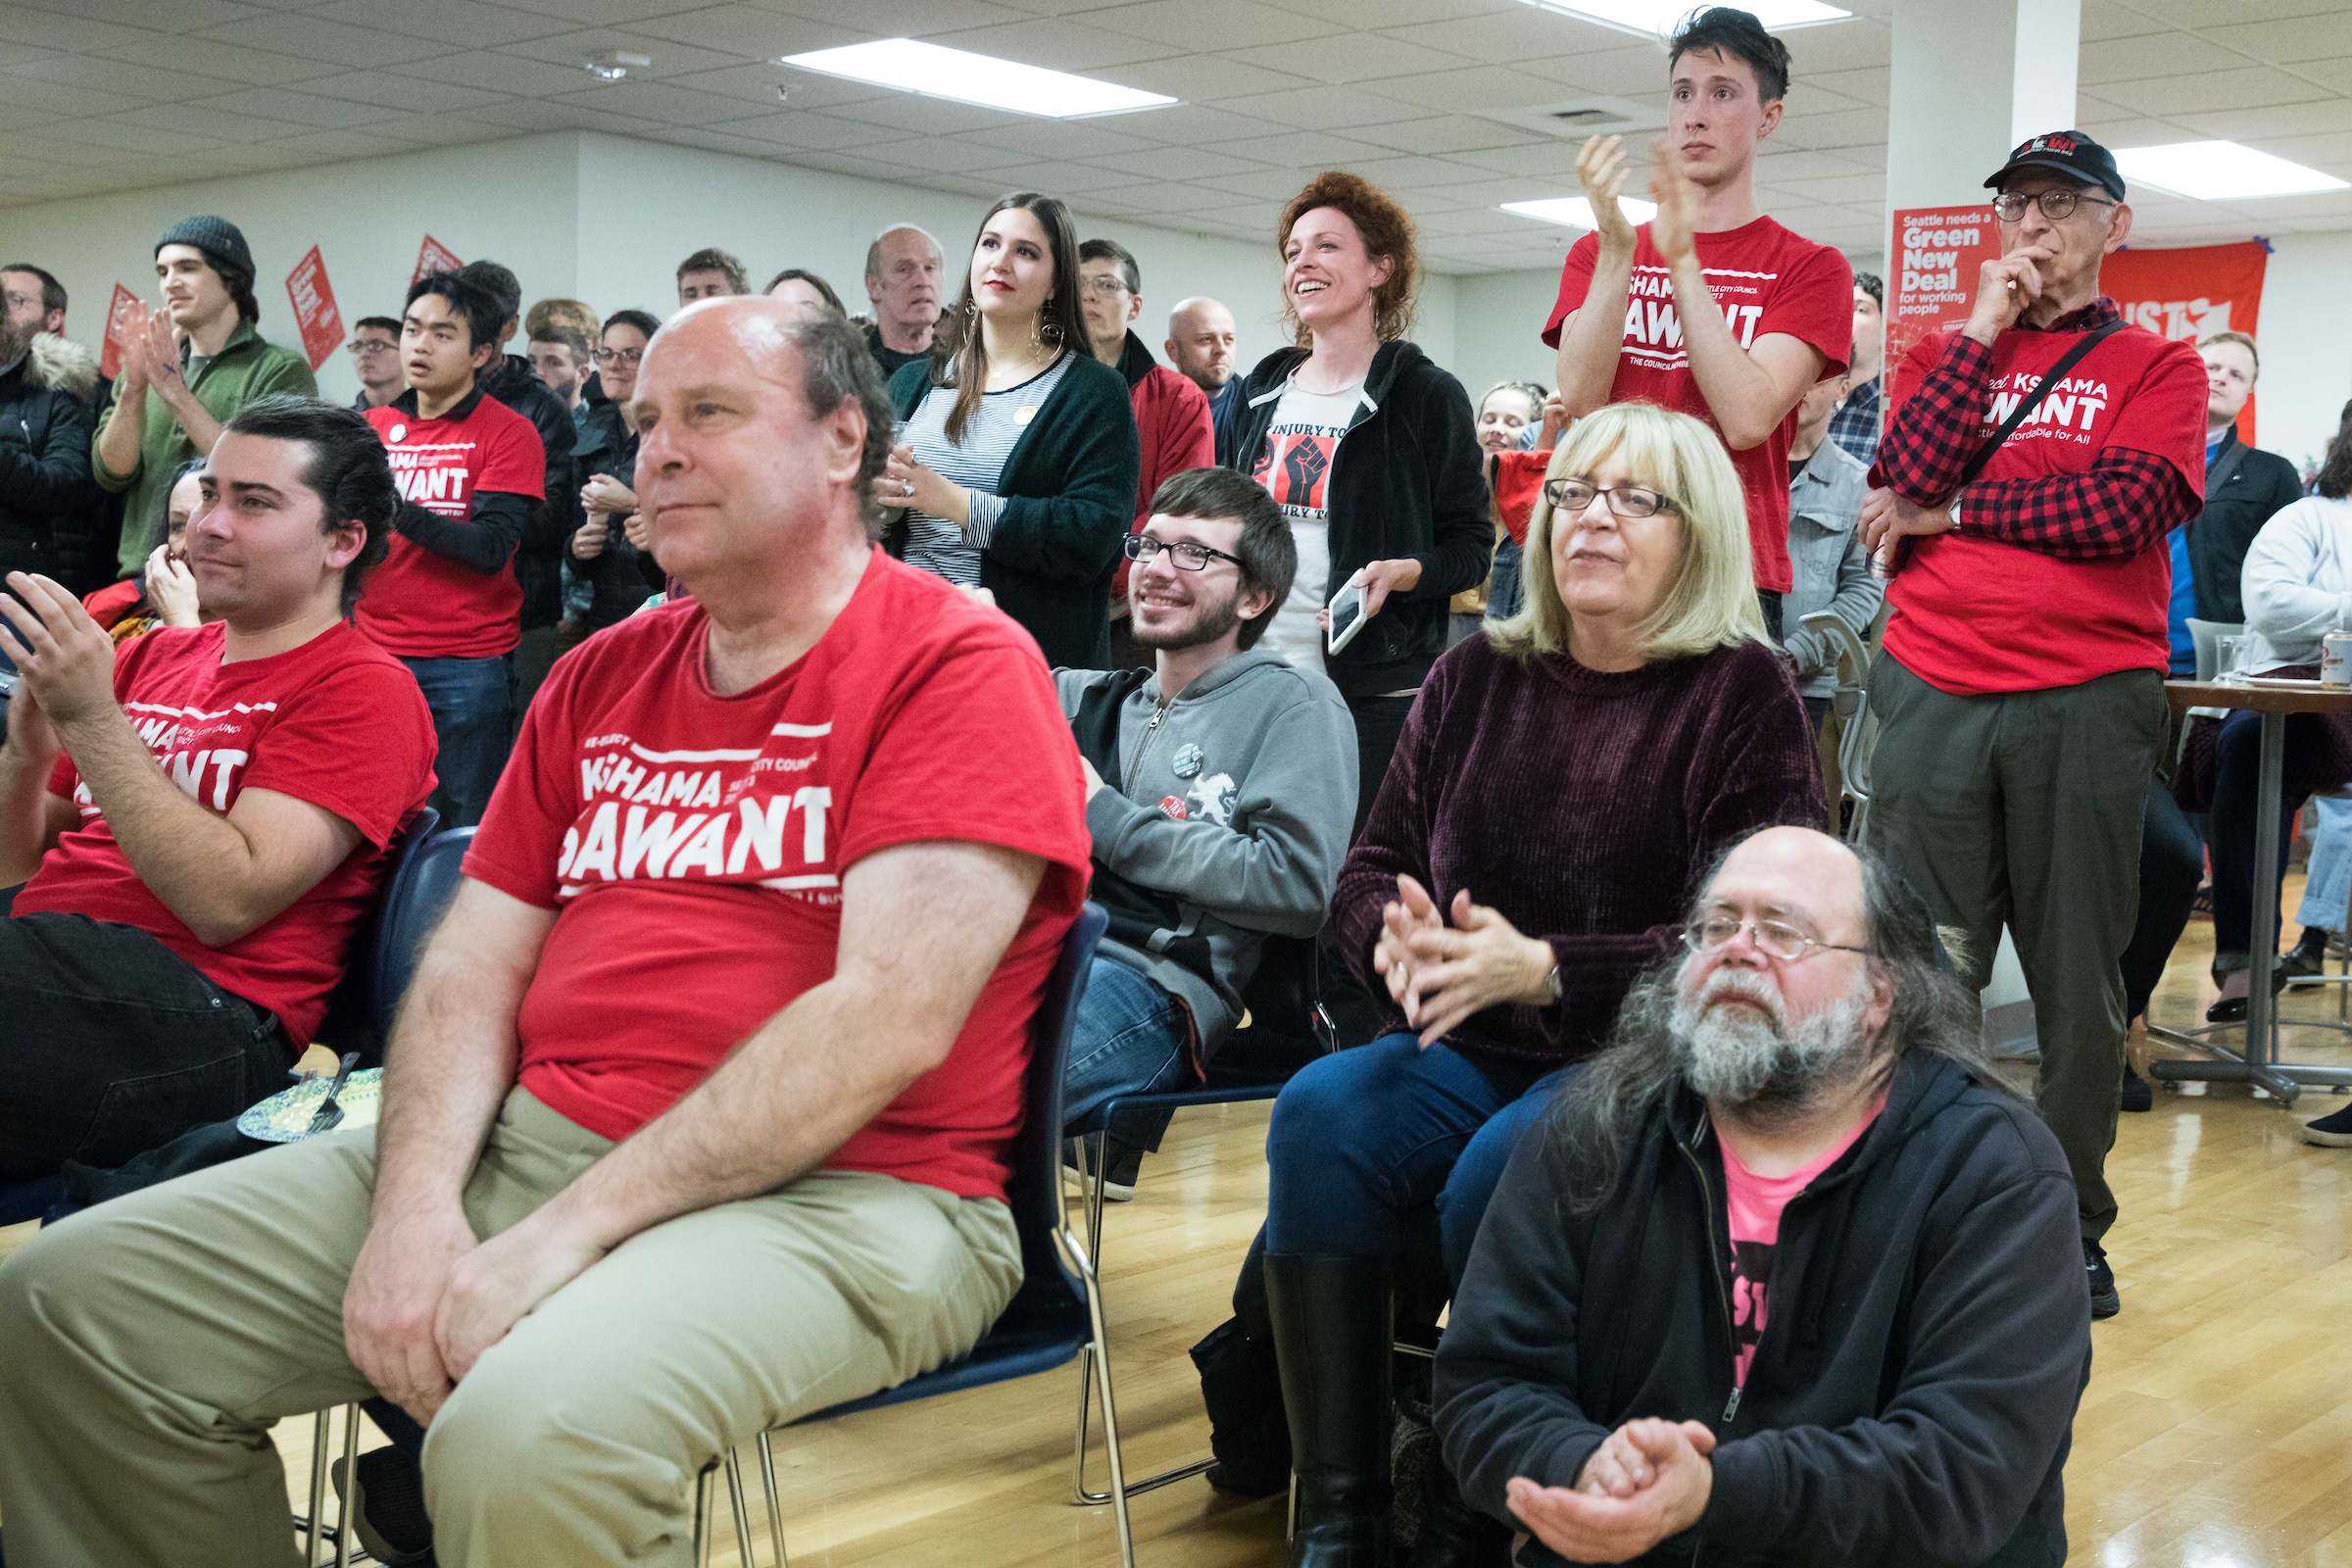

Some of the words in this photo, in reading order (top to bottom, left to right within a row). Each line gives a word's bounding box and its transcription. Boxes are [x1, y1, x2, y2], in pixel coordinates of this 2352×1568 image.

[1903, 215, 1943, 227] Seattle
[1946, 213, 1982, 224] needs
[1984, 214, 1991, 223] a
[1902, 227, 1980, 249] Green
[1902, 249, 1958, 270] New
[1629, 275, 1675, 299] SHAM
[1901, 268, 1958, 292] Deal
[1899, 292, 1917, 304] for
[1919, 291, 1967, 304] working
[1898, 304, 1939, 317] people
[1630, 356, 1643, 367] THE
[1643, 358, 1690, 370] COUNCILMEMBE
[2013, 372, 2108, 400] KSAMA
[1984, 392, 2106, 431] WANT
[1272, 423, 1325, 437] INJURY
[2054, 429, 2072, 440] for
[2073, 433, 2090, 445] All
[395, 467, 468, 502] WANT
[1169, 800, 1183, 817] TAX
